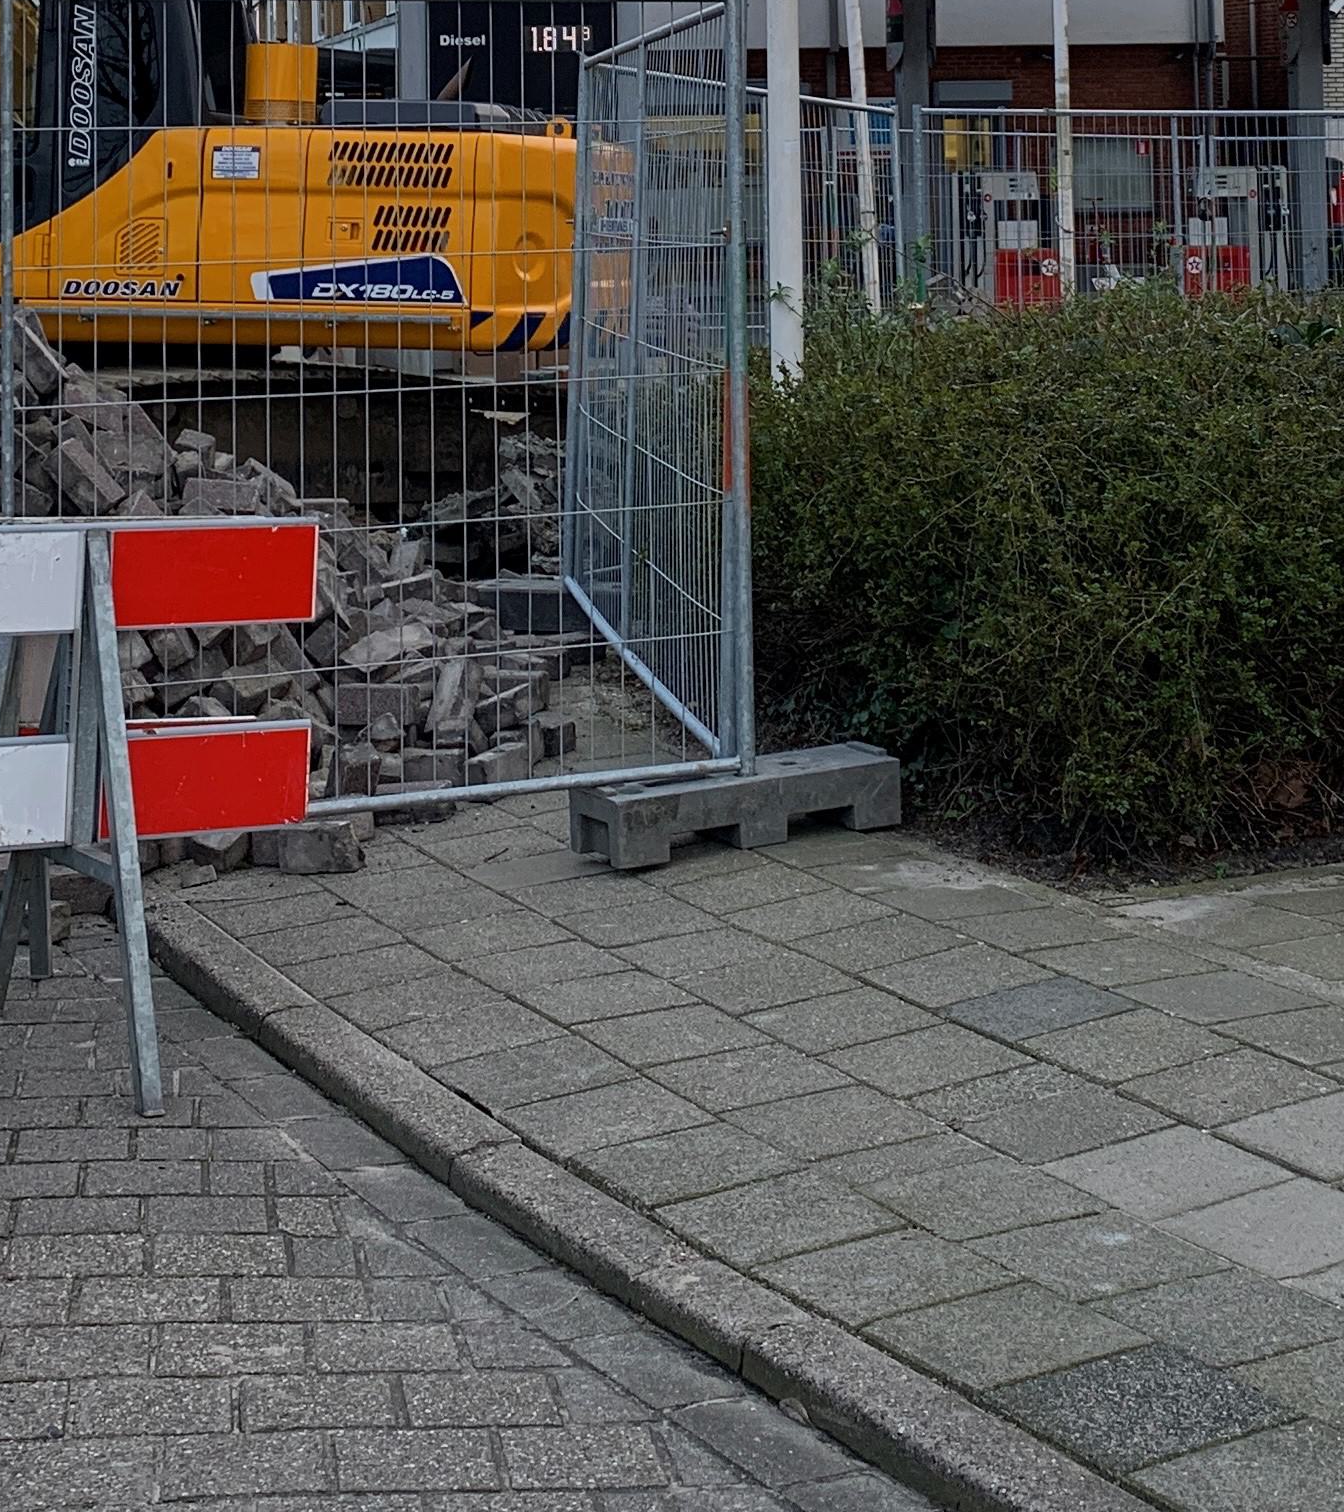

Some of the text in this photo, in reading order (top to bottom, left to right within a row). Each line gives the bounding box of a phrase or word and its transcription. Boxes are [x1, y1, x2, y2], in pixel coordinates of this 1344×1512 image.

[439, 34, 486, 46] Diesel
[68, 4, 96, 159] DOOSAN
[62, 279, 183, 297] DOOSAN
